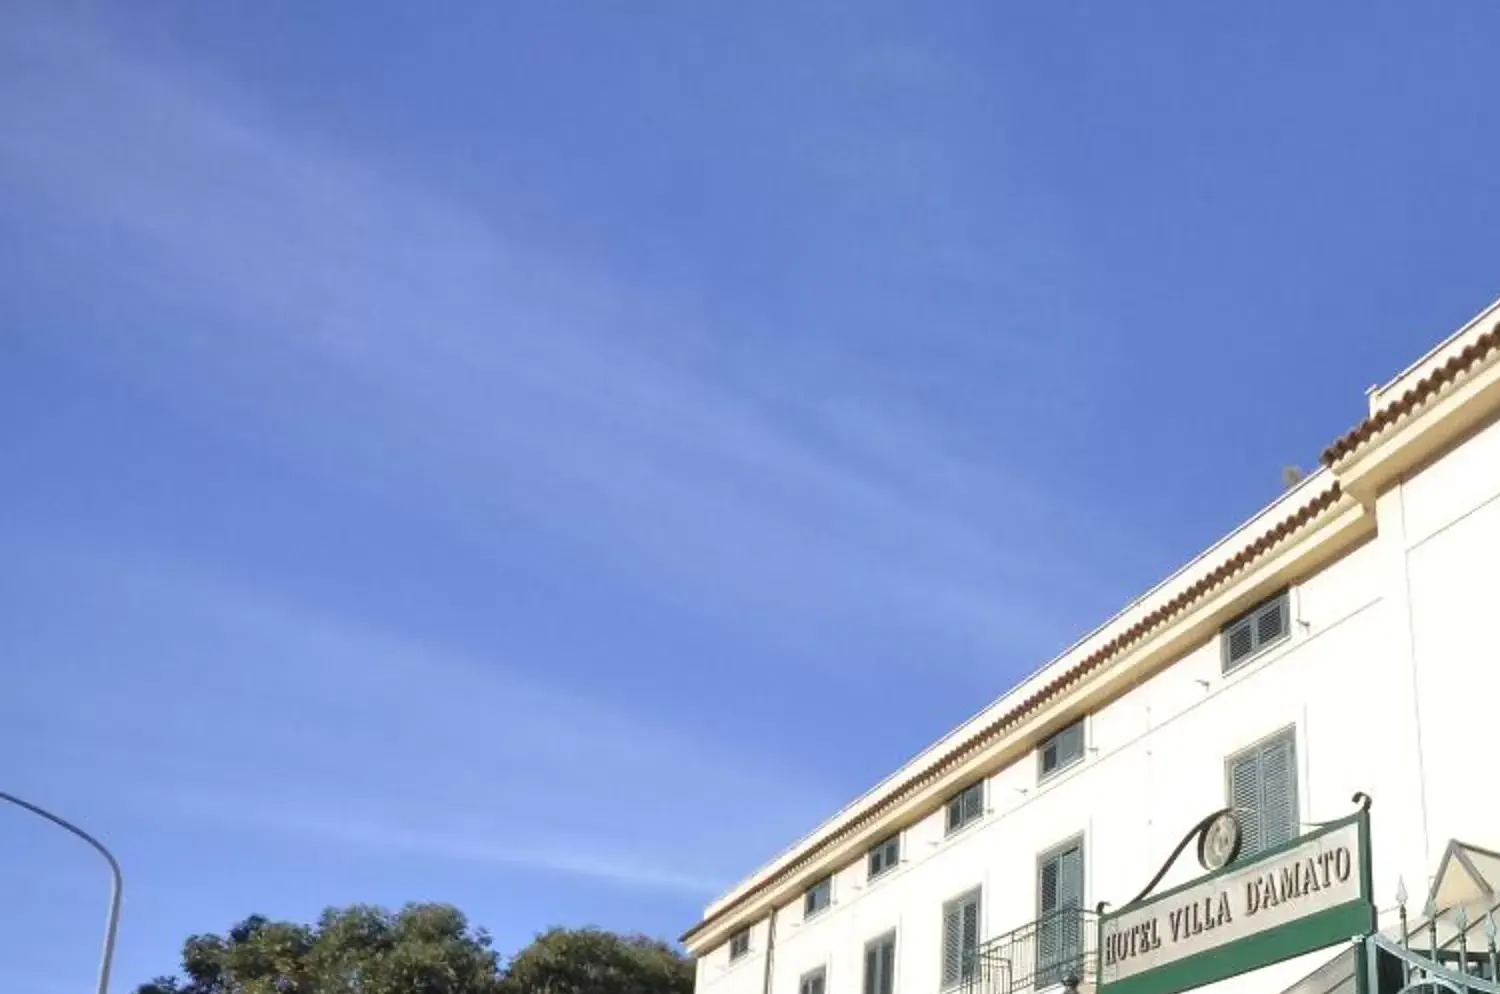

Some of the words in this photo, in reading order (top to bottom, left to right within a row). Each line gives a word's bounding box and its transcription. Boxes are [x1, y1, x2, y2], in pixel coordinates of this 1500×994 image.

[1105, 918, 1161, 966] HOTEL
[1168, 891, 1233, 943] VILLA
[1245, 846, 1352, 917] D'AMATO
